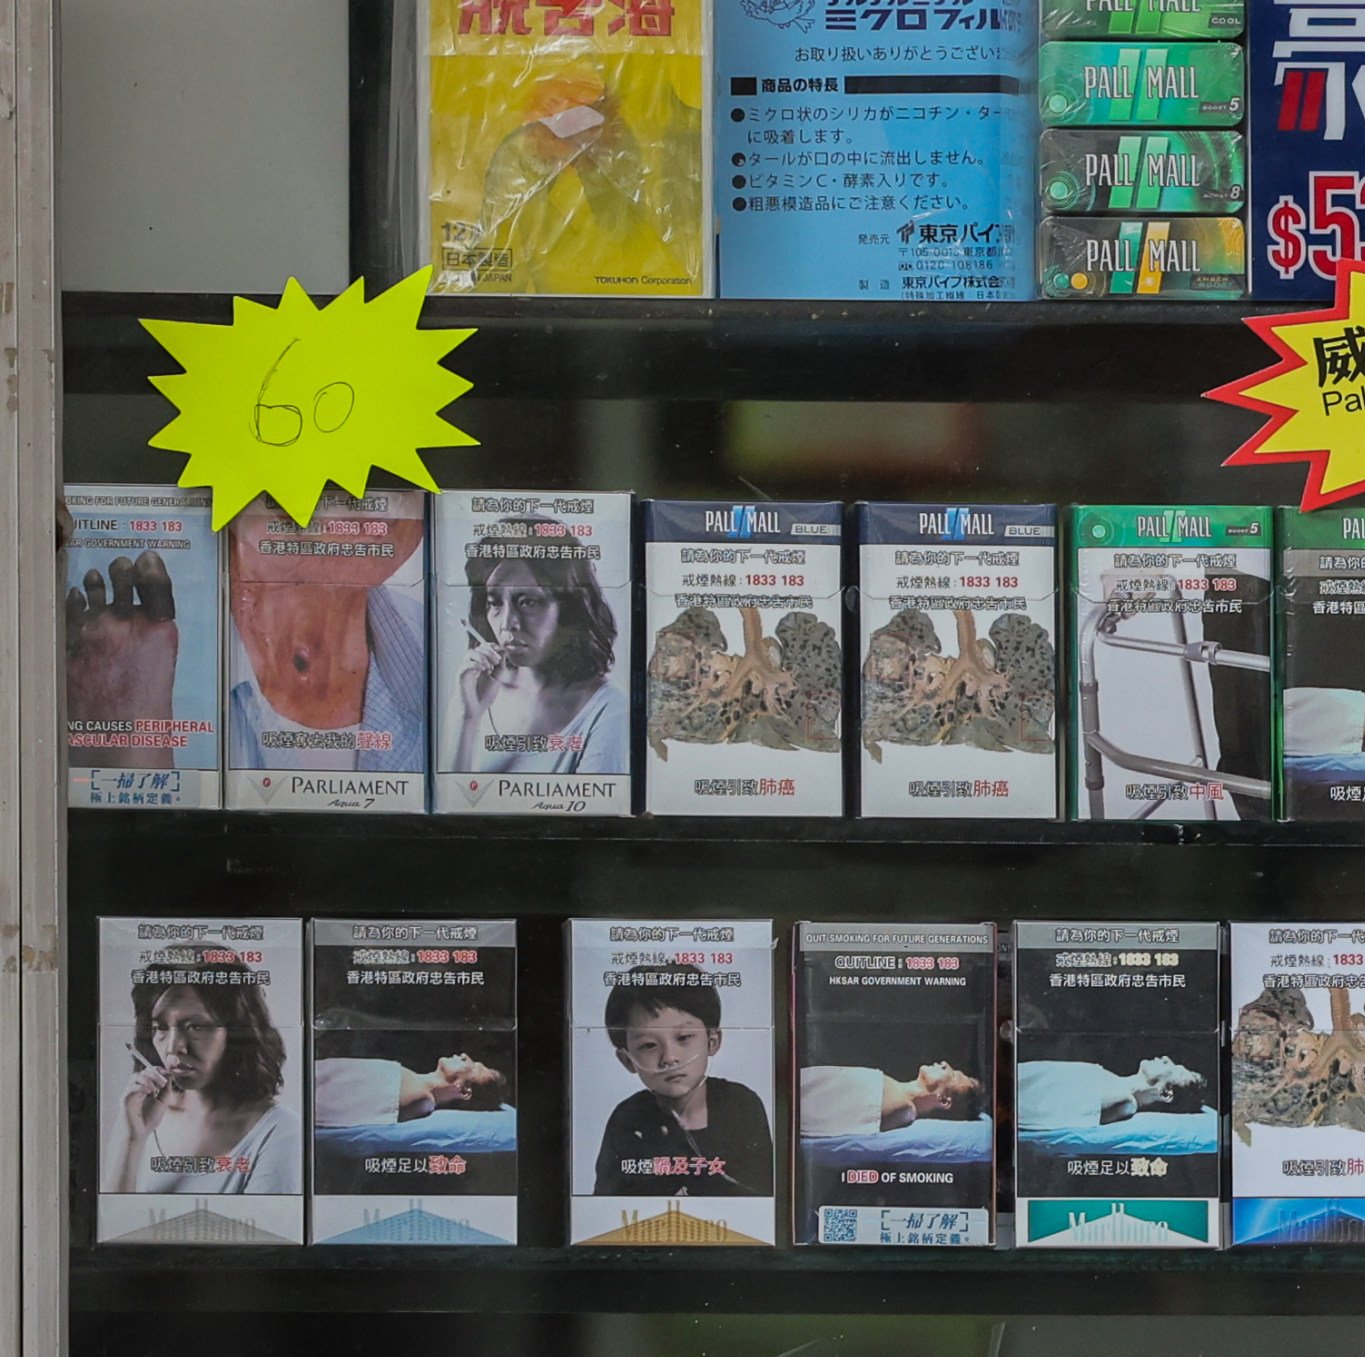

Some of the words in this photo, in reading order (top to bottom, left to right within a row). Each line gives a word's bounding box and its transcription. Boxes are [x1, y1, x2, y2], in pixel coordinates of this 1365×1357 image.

[762, 78, 838, 92] 商品の特長
[1084, 65, 1132, 100] PALL
[1147, 65, 1199, 100] MALL
[1228, 98, 1239, 112] 5
[1085, 153, 1132, 188] PALL
[1148, 153, 1200, 188] MALL
[1230, 186, 1240, 200] 8
[1086, 237, 1133, 273] PALL
[1149, 237, 1200, 273] MALL
[641, 276, 691, 285] Corporation
[705, 510, 738, 535] PALL
[746, 511, 781, 535] MALL
[795, 525, 828, 534] BLUE
[919, 513, 952, 536] PALL
[960, 513, 995, 536] MALL
[1137, 515, 1169, 538] PALL
[1177, 515, 1212, 538] MALL
[745, 574, 777, 587] 1833
[781, 574, 804, 587] 183
[86, 720, 133, 733] CAUSES
[132, 734, 187, 749] DISEASE
[291, 777, 410, 797] PARLIAMENT
[498, 779, 616, 799] PARLIAMENT
[1332, 954, 1364, 967] 1833
[828, 976, 859, 987] HKSAR
[861, 976, 923, 987] GOVERNMENT
[924, 976, 967, 987] WARNING
[881, 1172, 897, 1184] OF
[899, 1171, 954, 1185] SMOKING
